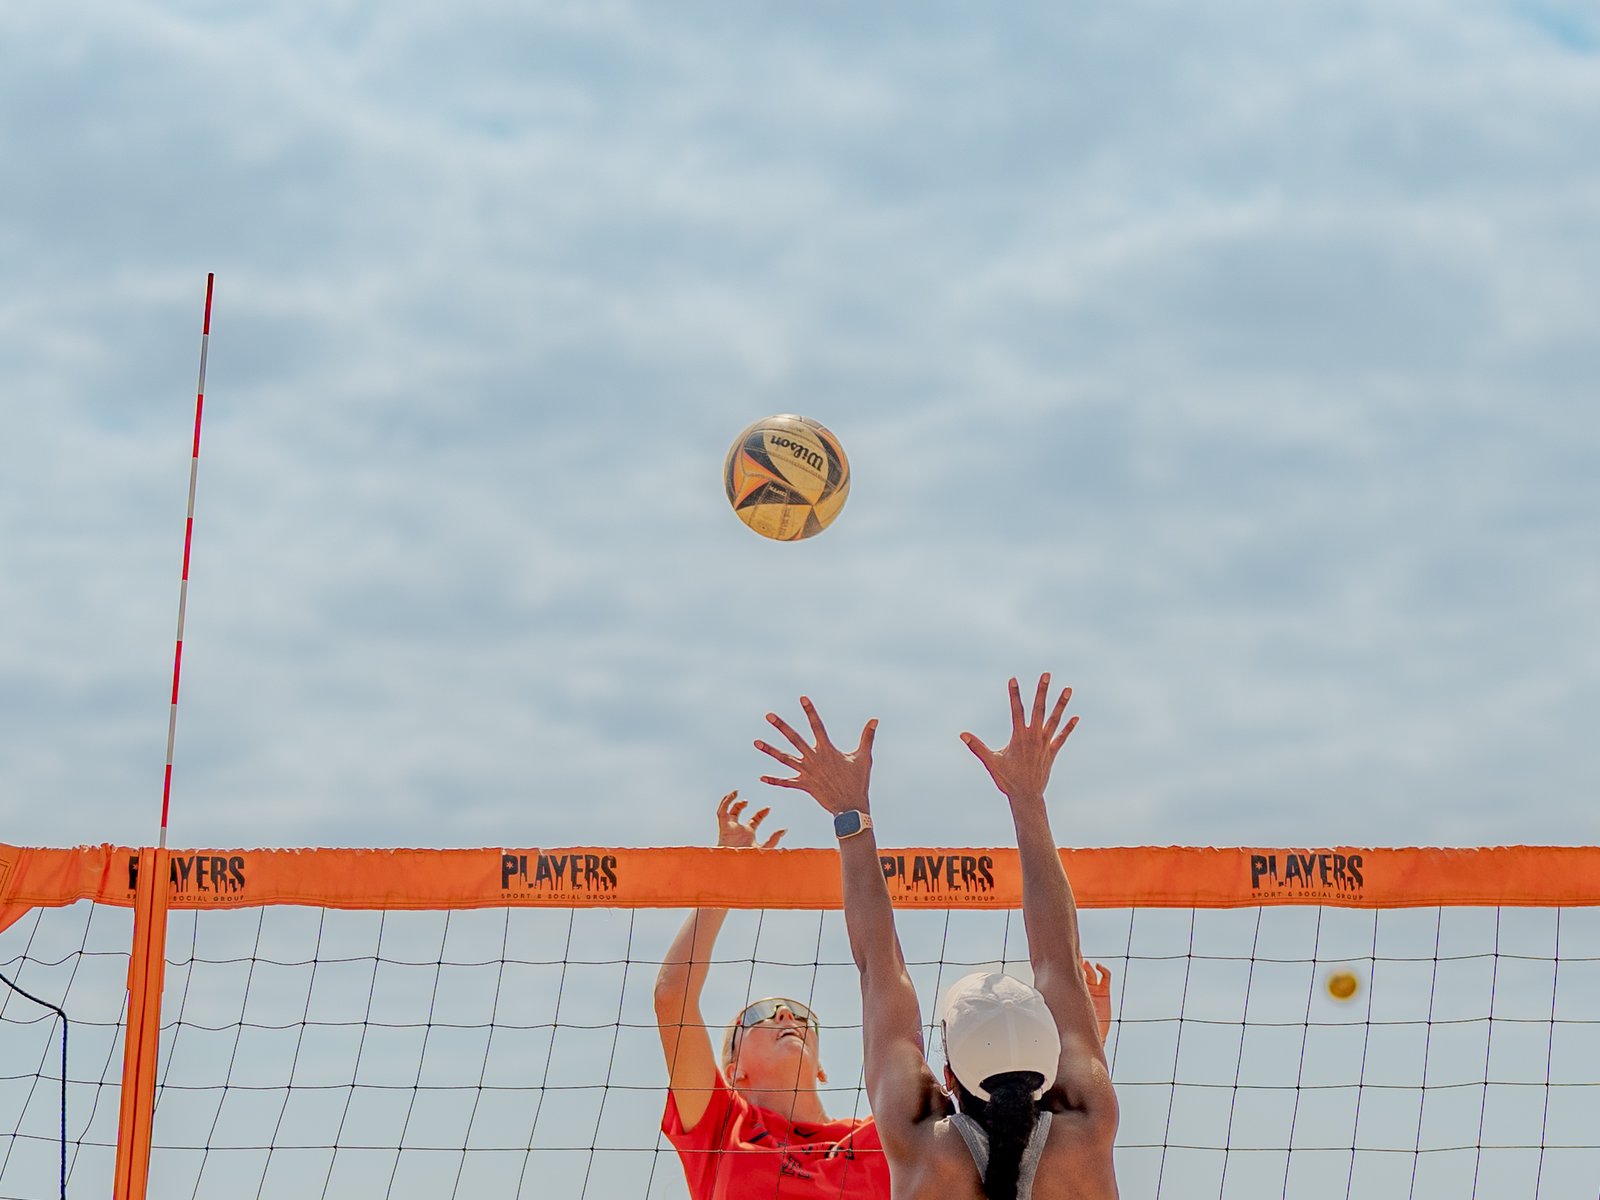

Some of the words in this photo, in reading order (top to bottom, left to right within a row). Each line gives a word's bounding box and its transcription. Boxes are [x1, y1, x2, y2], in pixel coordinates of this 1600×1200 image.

[770, 435, 824, 472] Wilson
[501, 854, 618, 892] PLAYERS
[880, 855, 995, 893] PLAYERS
[1251, 854, 1364, 892] PLAYERS
